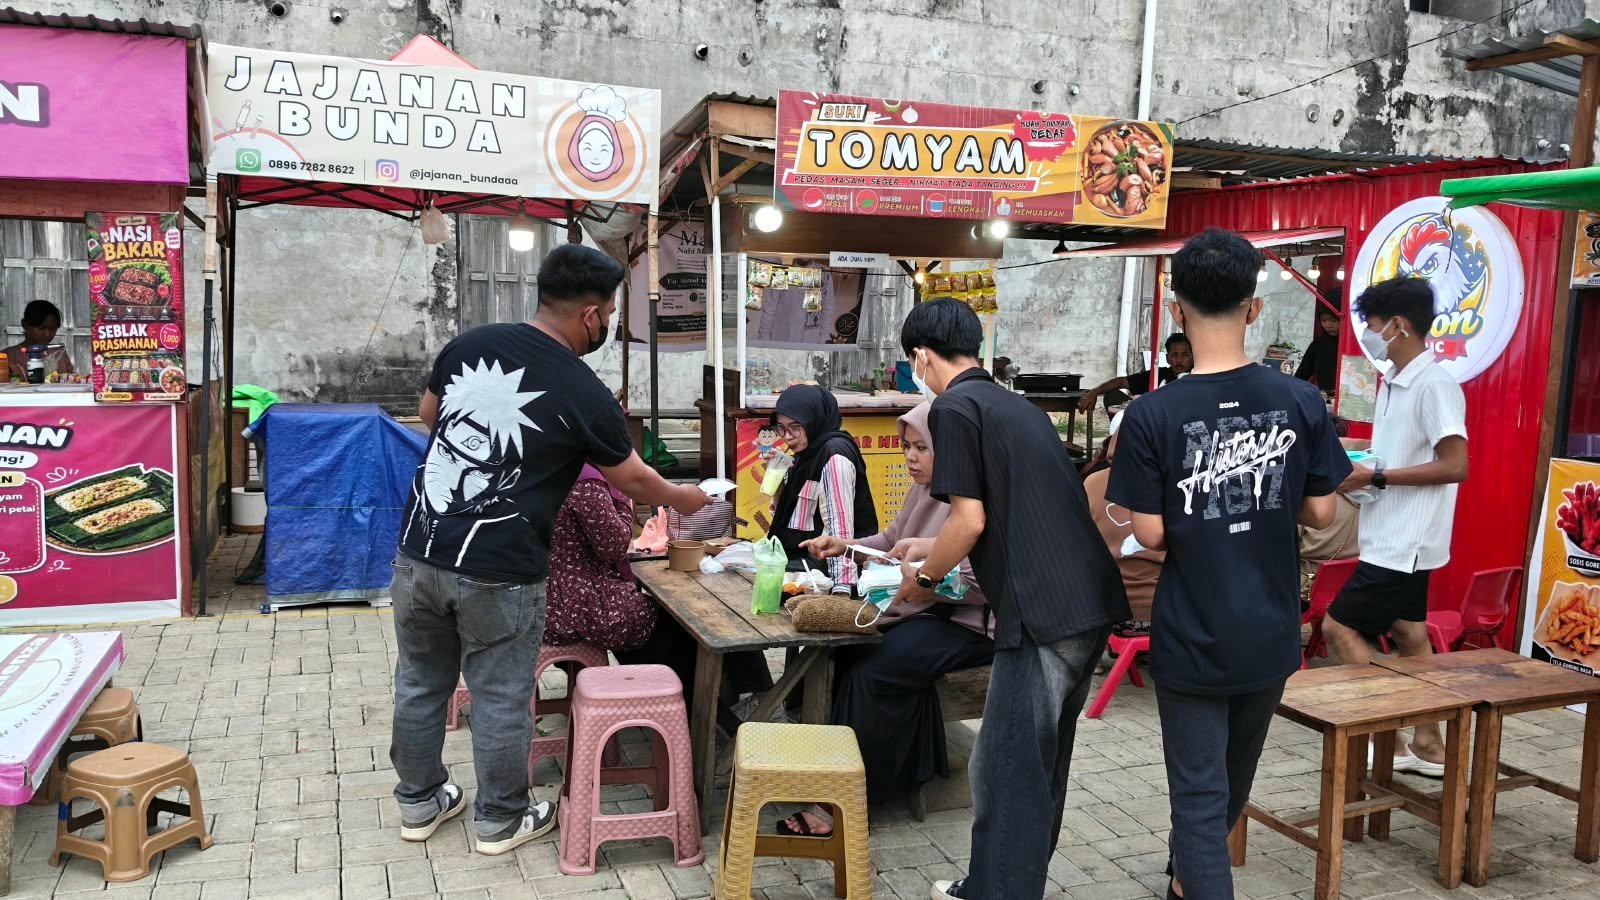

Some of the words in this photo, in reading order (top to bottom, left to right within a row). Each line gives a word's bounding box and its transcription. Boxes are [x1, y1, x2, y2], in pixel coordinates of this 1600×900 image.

[224, 56, 526, 118] JAJANAN
[824, 104, 862, 119] SUKI
[278, 100, 502, 154] BUNDA
[1031, 128, 1066, 140] SEDAP
[807, 128, 1026, 175] TOMYAM
[269, 159, 297, 170] 0896
[300, 161, 326, 172] 7282
[328, 164, 354, 175] 8622
[409, 169, 518, 185] @jajanan_bundaaa
[909, 179, 944, 187] NIKMAT
[879, 203, 919, 211] PREMIUM
[948, 206, 986, 214] LENGKAP
[1014, 208, 1065, 218] MEMUASKAN
[109, 225, 152, 243] NASI
[102, 240, 166, 261] BAKAR
[98, 323, 148, 339] SEBLAK
[92, 338, 158, 352] PRASMANAN
[1177, 425, 1296, 514] History
[9, 504, 37, 515] petai
[1569, 557, 1584, 567] SOSIS
